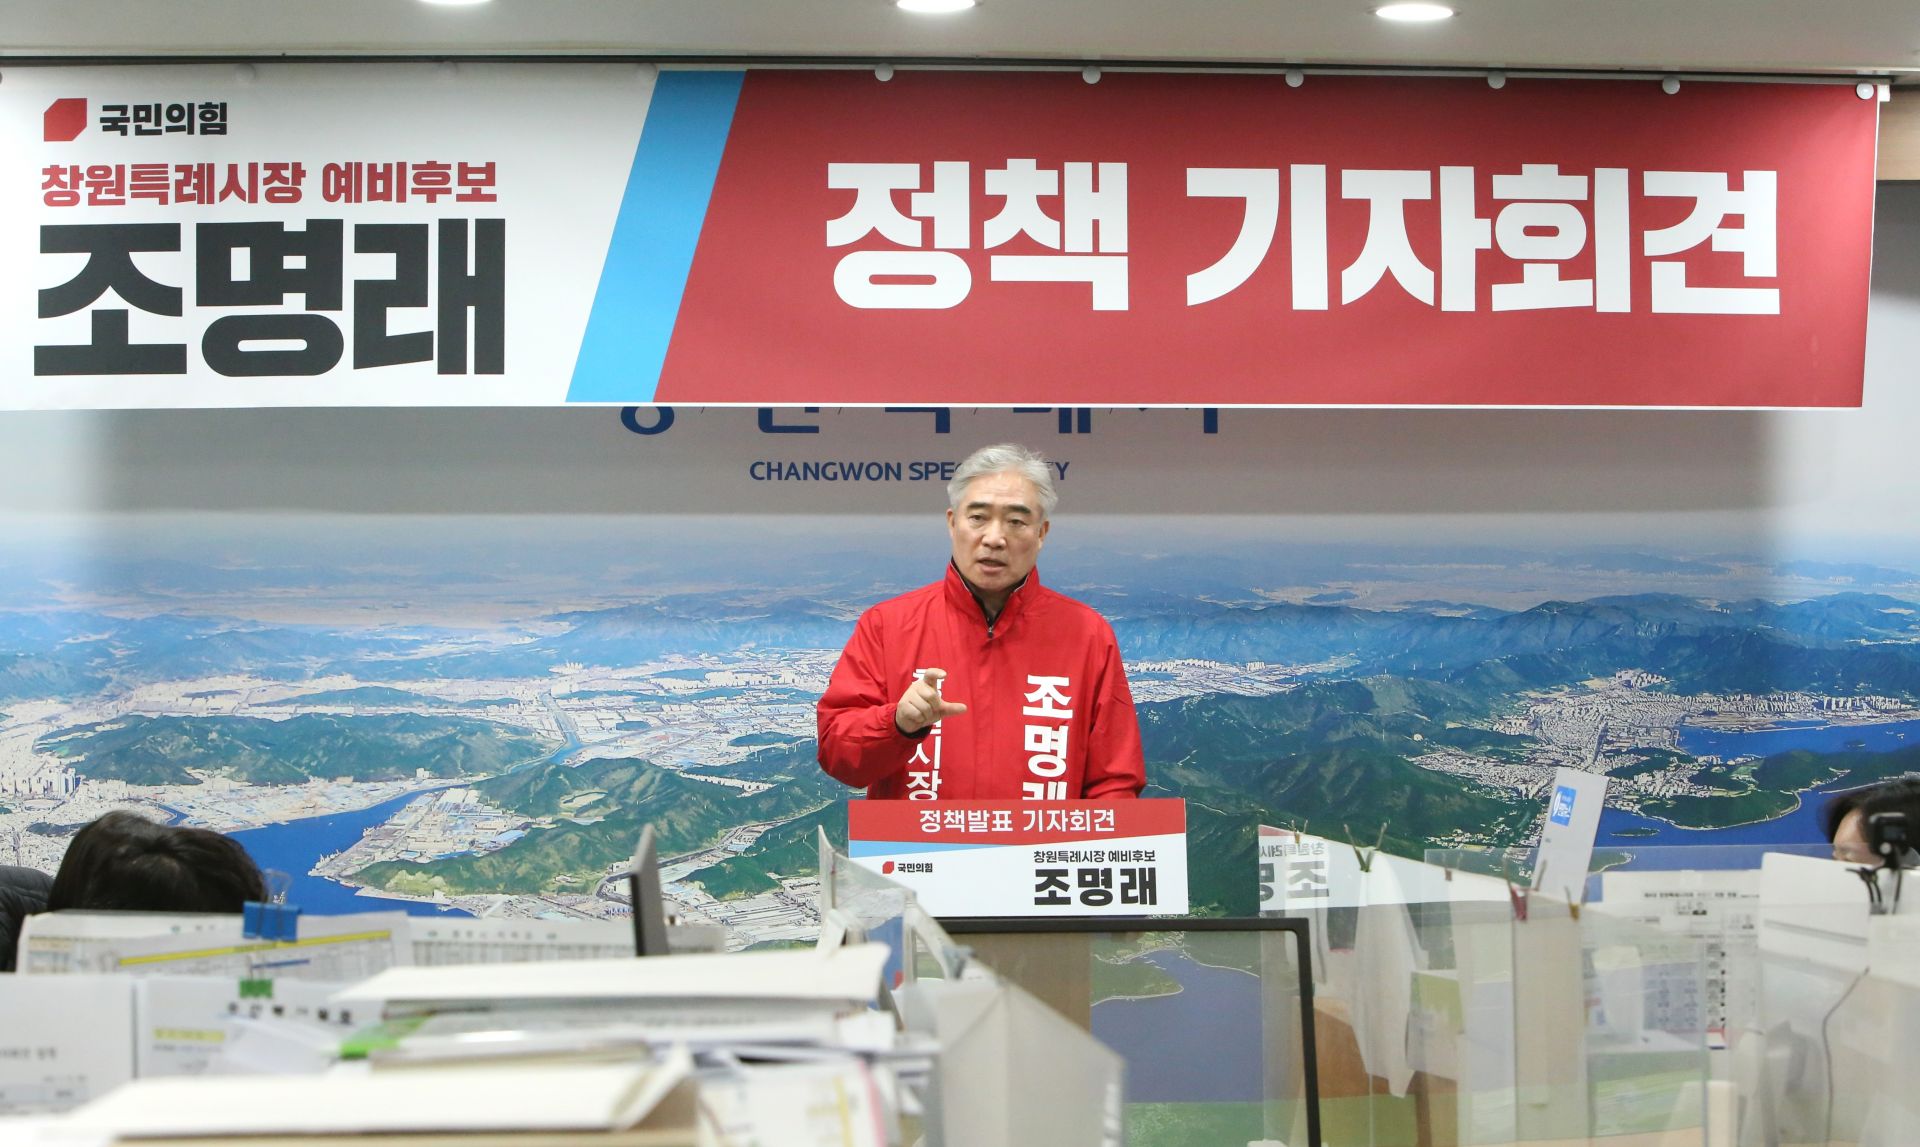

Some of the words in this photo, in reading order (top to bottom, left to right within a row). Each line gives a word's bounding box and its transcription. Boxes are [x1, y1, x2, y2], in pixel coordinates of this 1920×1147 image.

[99, 101, 228, 137] 국민의힘
[41, 161, 306, 207] 창원특례시장
[321, 160, 497, 204] 예비후보
[826, 158, 1129, 312] 정책
[1186, 163, 1780, 316] 기자회견
[34, 217, 505, 377] 조명래
[749, 461, 901, 481] CHANGWON
[908, 461, 962, 481] SPE
[919, 808, 1014, 834] 정책발표
[1022, 808, 1116, 833] 기자회견
[897, 862, 933, 873] 국민의힘
[1033, 849, 1106, 864] 창원특례시장
[1108, 849, 1156, 863] 예비후보
[1033, 867, 1157, 907] 조명래
